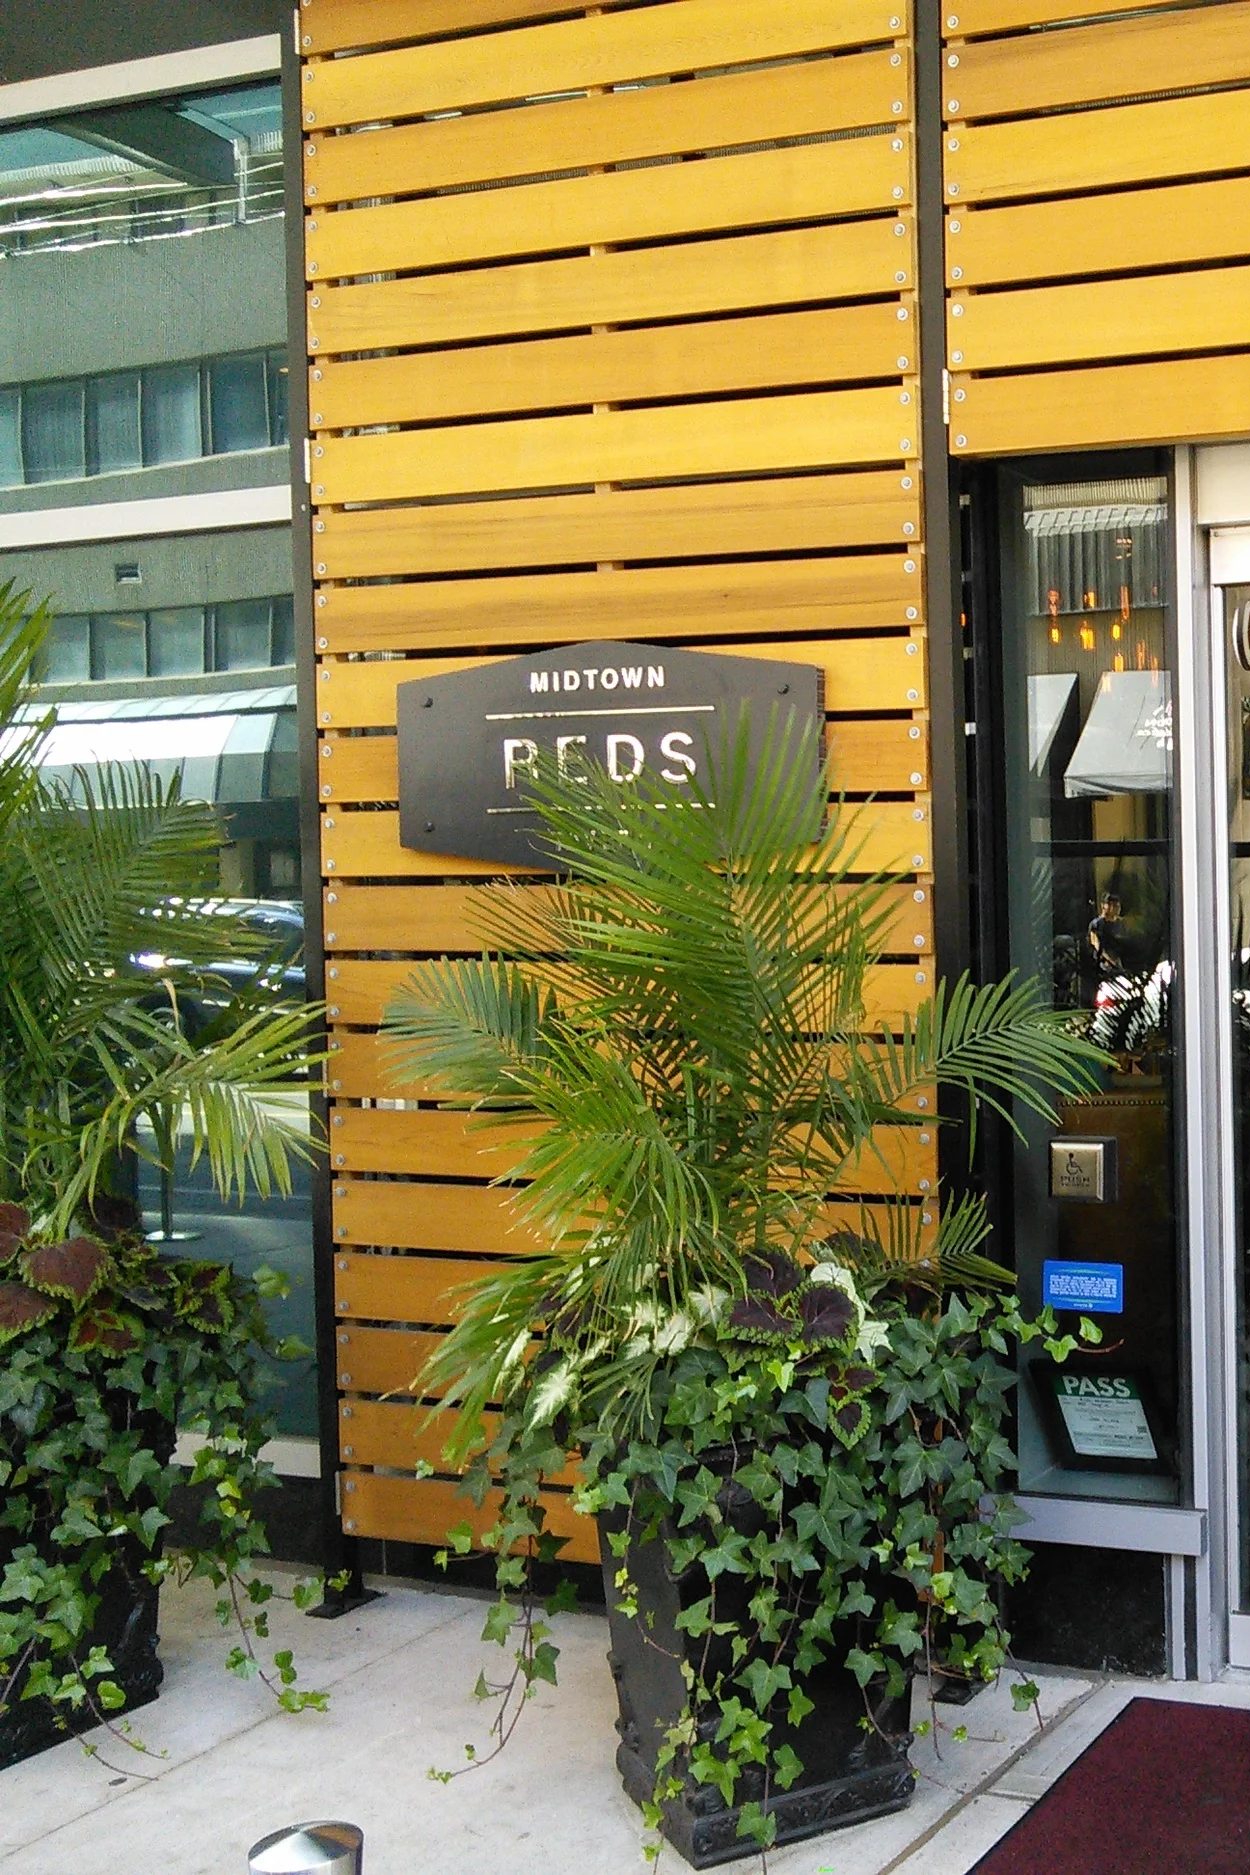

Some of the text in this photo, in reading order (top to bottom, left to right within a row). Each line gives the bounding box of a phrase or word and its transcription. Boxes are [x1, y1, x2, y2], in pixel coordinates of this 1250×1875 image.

[529, 665, 665, 693] MIDTOWN
[503, 731, 697, 790] REDS
[1062, 1375, 1131, 1398] PASS
